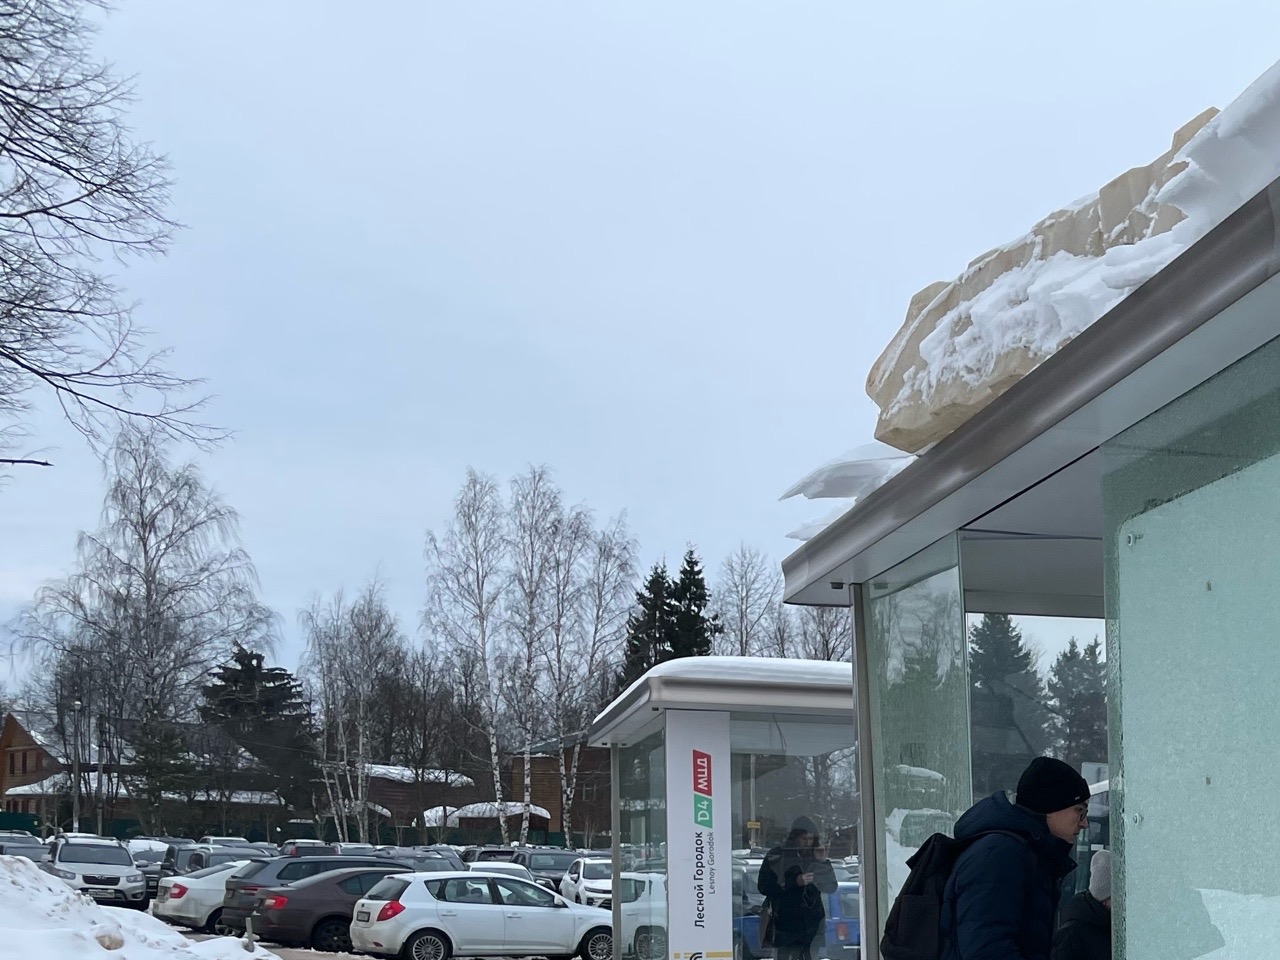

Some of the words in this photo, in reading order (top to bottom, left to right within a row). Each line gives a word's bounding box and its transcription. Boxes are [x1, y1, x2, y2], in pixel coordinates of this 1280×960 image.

[697, 757, 709, 790] МЦД
[697, 800, 710, 822] D4
[693, 831, 705, 880] Городок
[707, 831, 715, 866] Gorodok
[708, 867, 717, 894] Lesnoy
[693, 884, 705, 929] Лесной
